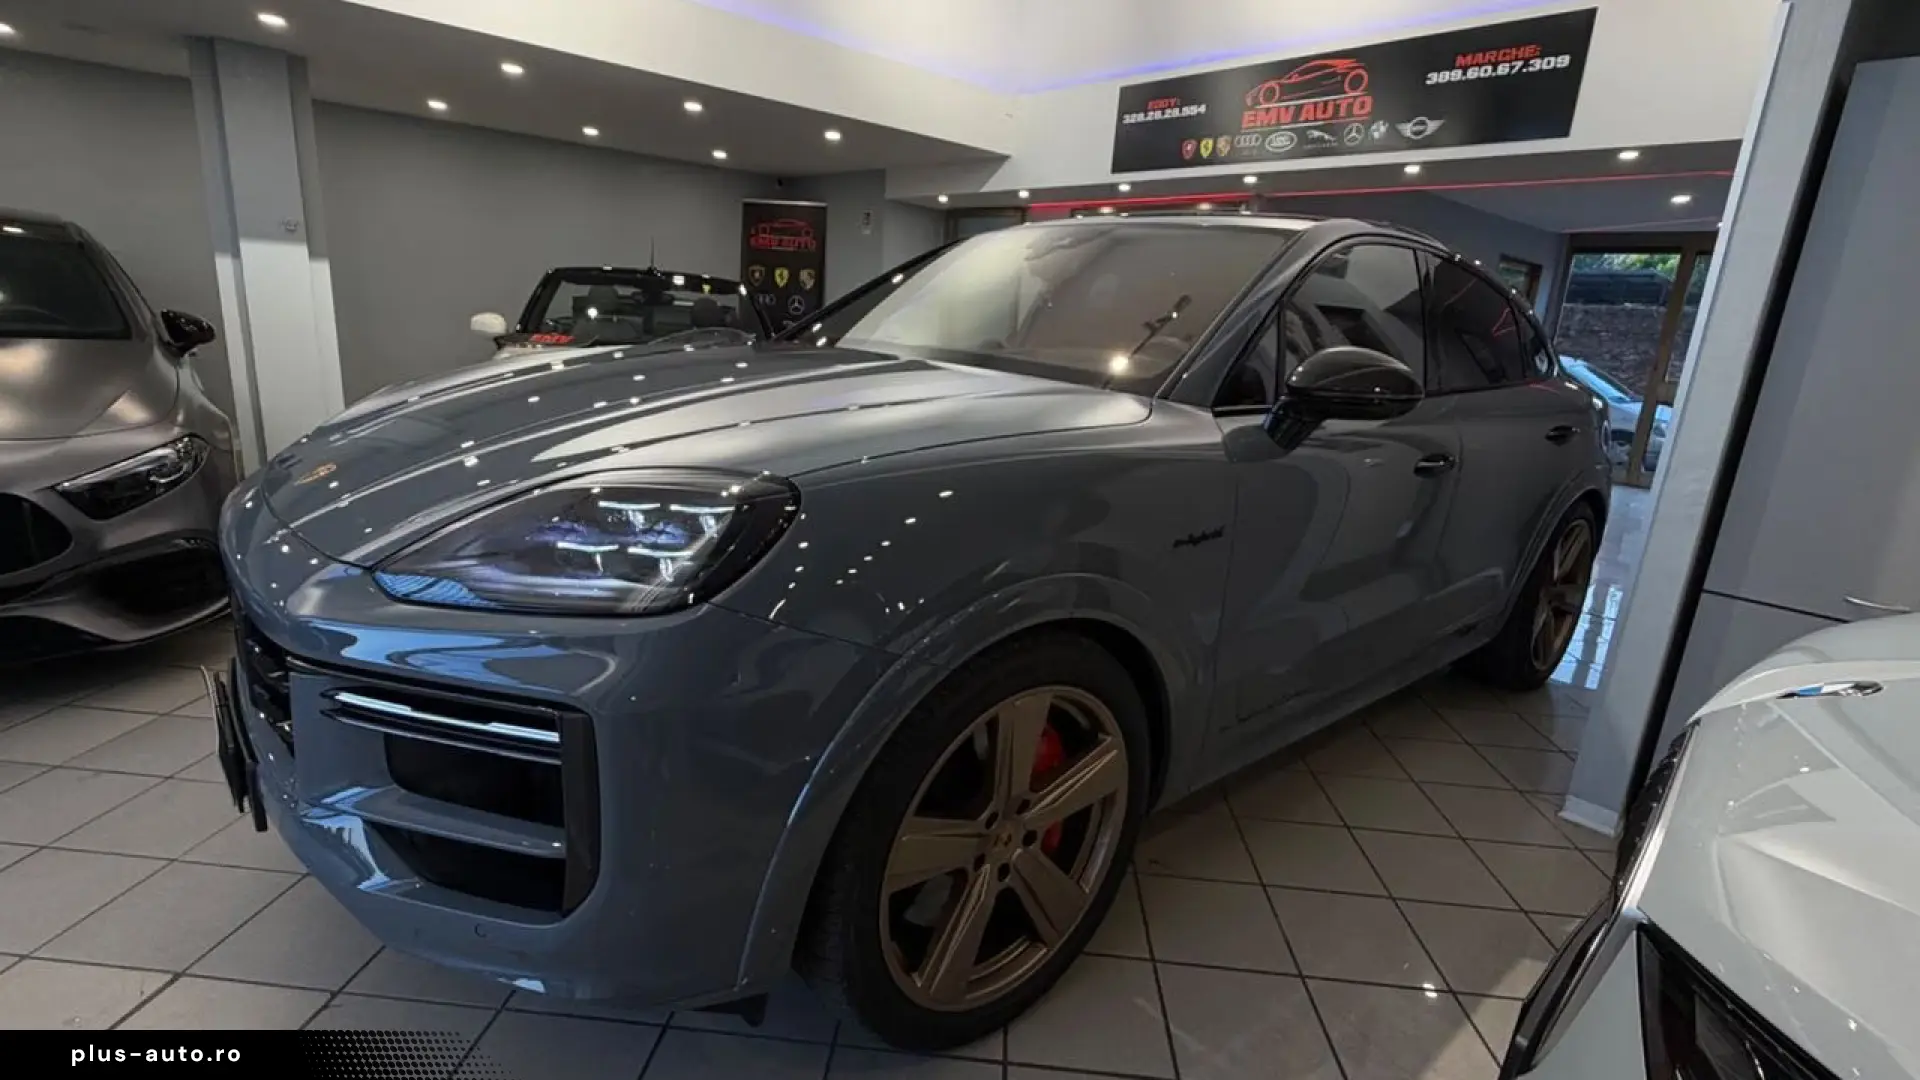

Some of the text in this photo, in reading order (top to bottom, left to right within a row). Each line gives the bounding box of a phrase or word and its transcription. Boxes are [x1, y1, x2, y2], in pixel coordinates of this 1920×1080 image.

[1425, 54, 1572, 85] 389.60.67.309
[1455, 44, 1542, 67] MARCHE:
[1240, 95, 1373, 129] EMV AUTO
